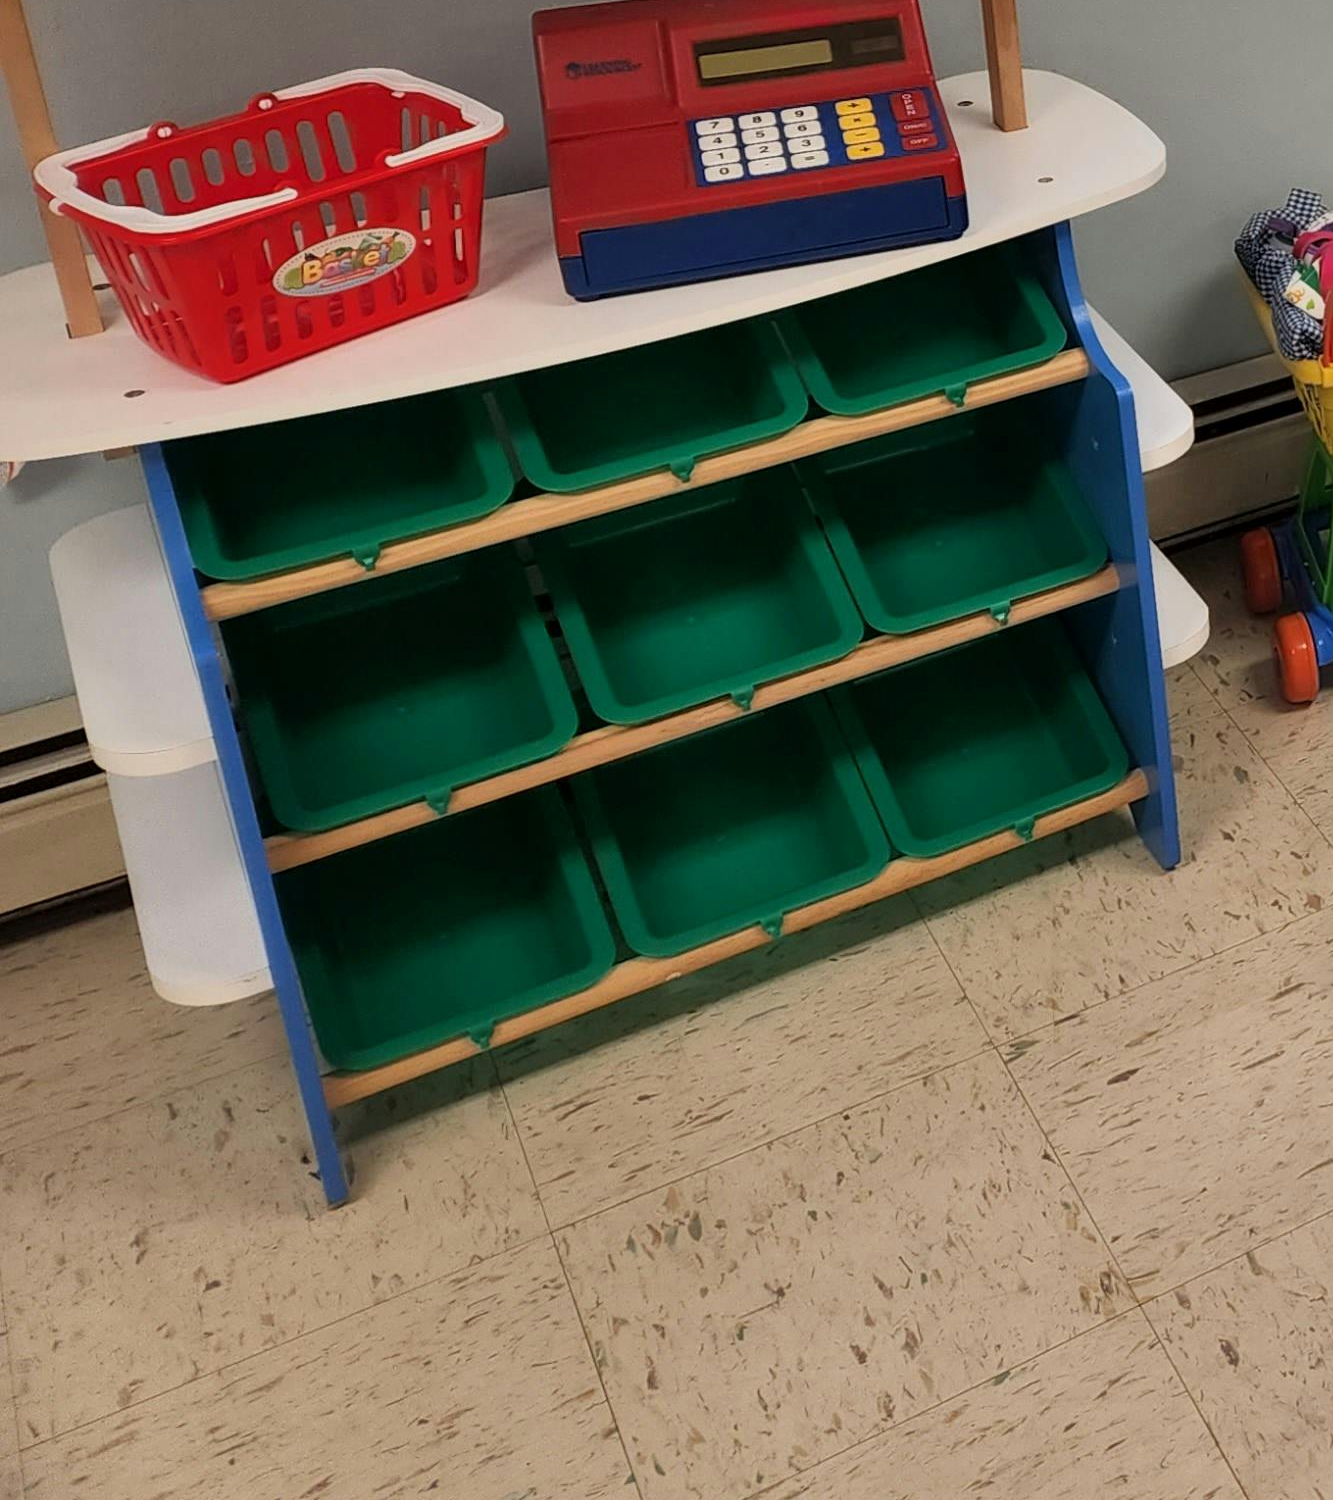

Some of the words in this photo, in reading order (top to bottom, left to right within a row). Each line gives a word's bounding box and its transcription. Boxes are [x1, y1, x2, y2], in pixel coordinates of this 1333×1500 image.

[709, 120, 719, 130] 7
[752, 115, 762, 124] 8
[794, 109, 805, 118] 9
[712, 136, 723, 145] 4
[755, 130, 766, 139] 5
[797, 124, 808, 132] 6
[759, 145, 769, 154] 2
[801, 139, 812, 147] 3
[302, 243, 390, 285] Basket
